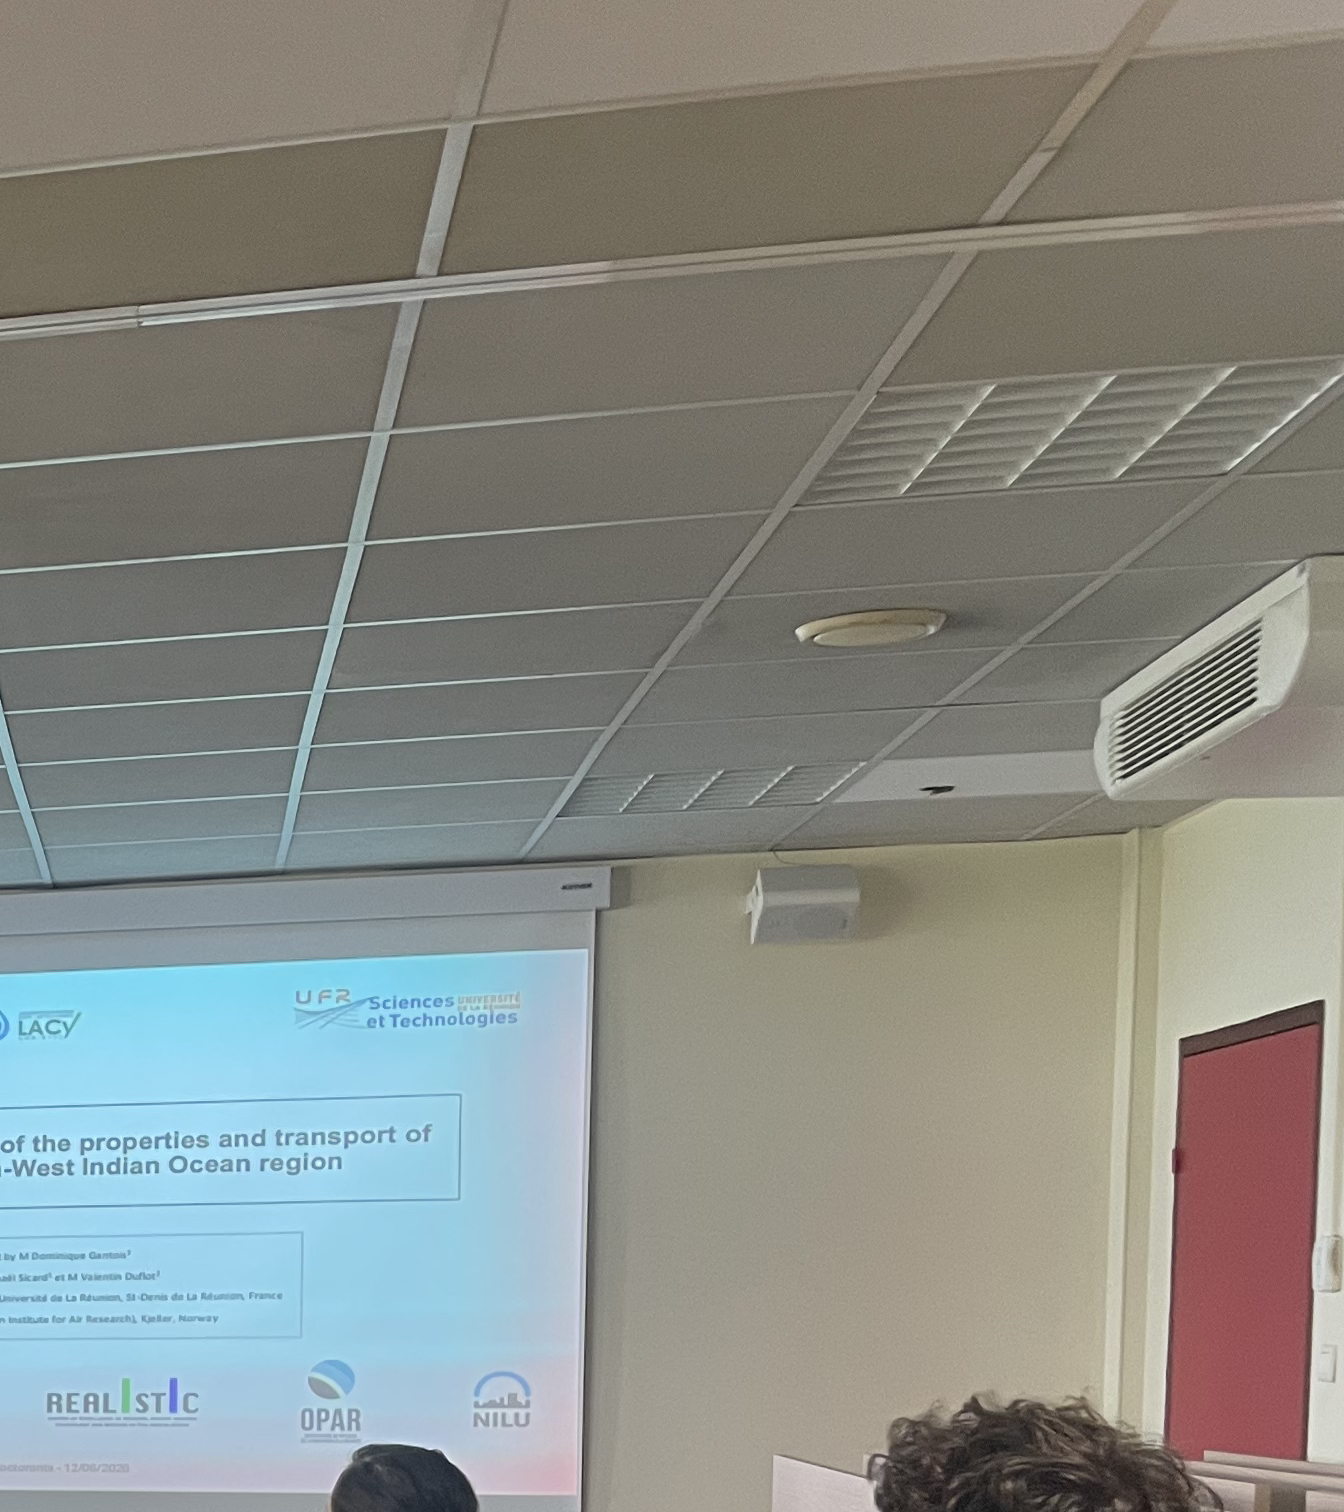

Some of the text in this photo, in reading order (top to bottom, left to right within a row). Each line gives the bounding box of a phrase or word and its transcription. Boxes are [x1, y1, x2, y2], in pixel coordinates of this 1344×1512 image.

[295, 988, 352, 1005] UFR
[368, 995, 455, 1010] Sciences
[366, 1011, 518, 1029] et Technologies
[0, 1134, 26, 1154] of
[32, 1133, 72, 1153] the
[79, 1129, 210, 1157] properties
[218, 1127, 267, 1149] and
[274, 1125, 397, 1150] transport
[405, 1123, 433, 1143] of
[82, 1155, 160, 1176] Indian
[168, 1153, 251, 1174] Ocean
[259, 1152, 344, 1176] region
[3, 1252, 17, 1263] by
[18, 1252, 30, 1261] M
[67, 1272, 79, 1281] M
[46, 1377, 200, 1415] REALISTIC
[300, 1406, 362, 1432] OPAR
[473, 1411, 531, 1428] NILU
